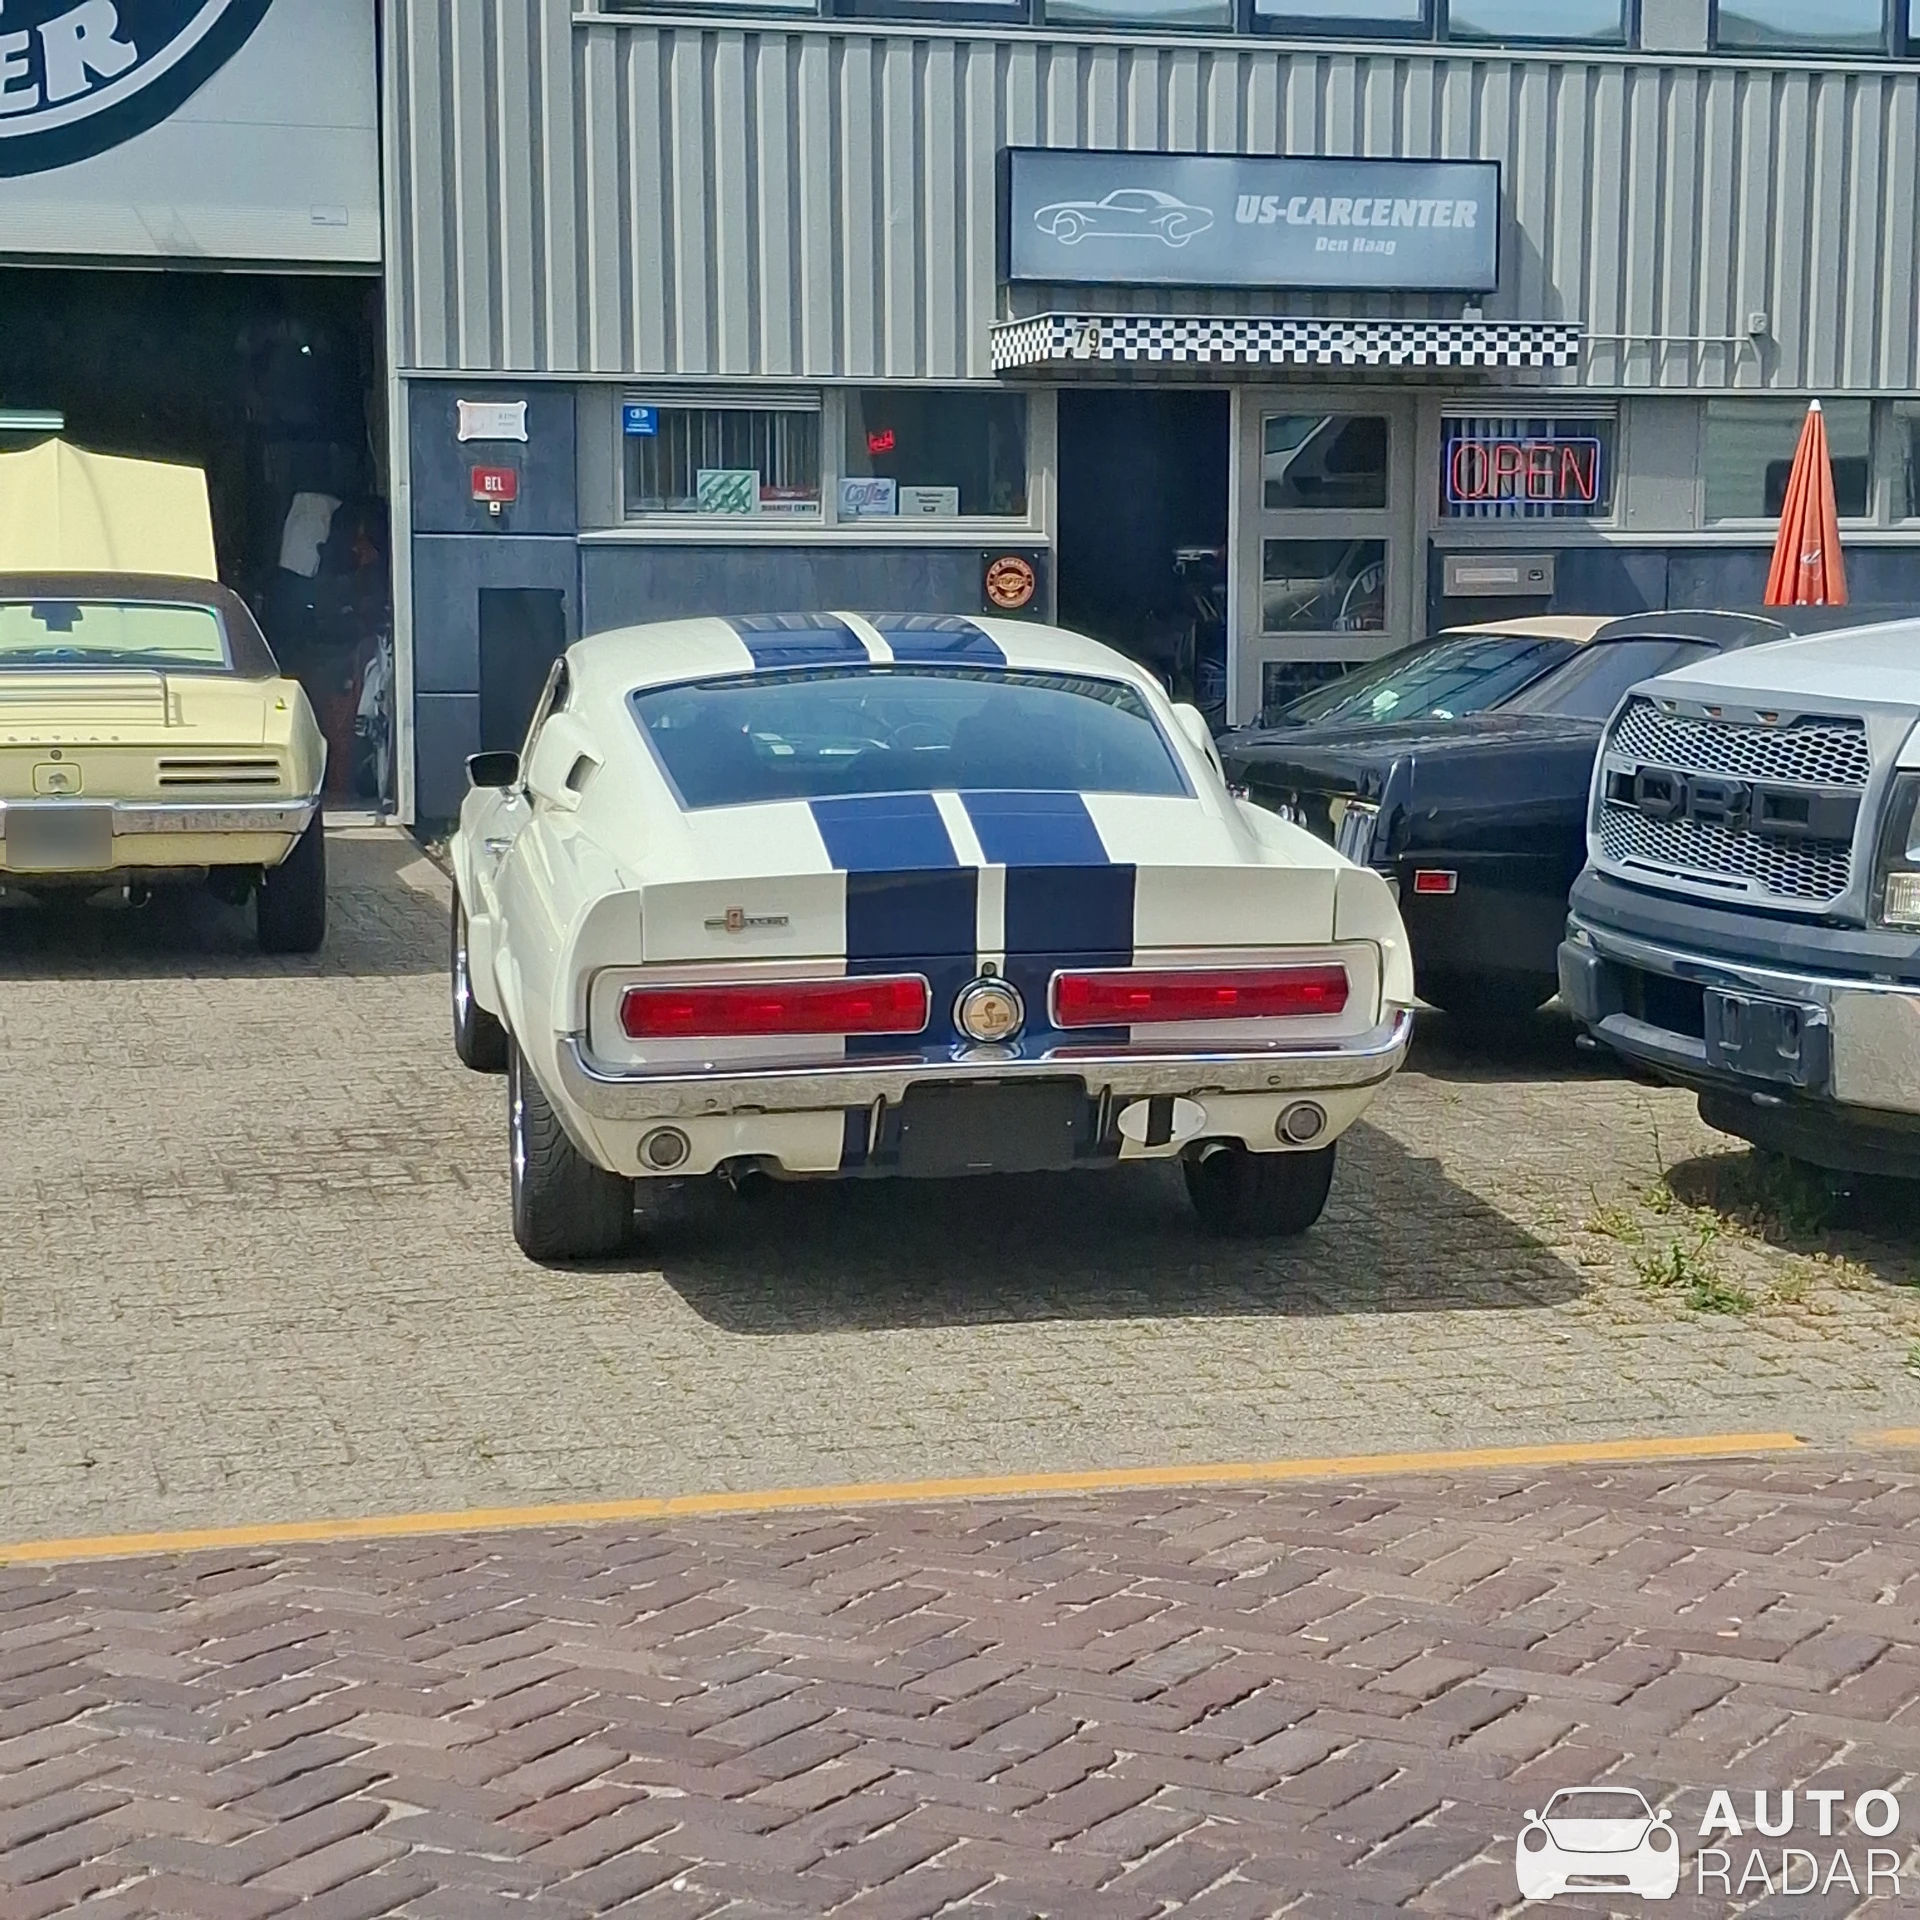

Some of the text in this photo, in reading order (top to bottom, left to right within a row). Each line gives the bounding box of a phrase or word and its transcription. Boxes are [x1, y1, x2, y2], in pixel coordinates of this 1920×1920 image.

[1235, 195, 1477, 228] US-CARCENTER
[1315, 237, 1396, 255] Den Haag
[1074, 328, 1099, 348] 79
[1453, 444, 1595, 499] OPEN
